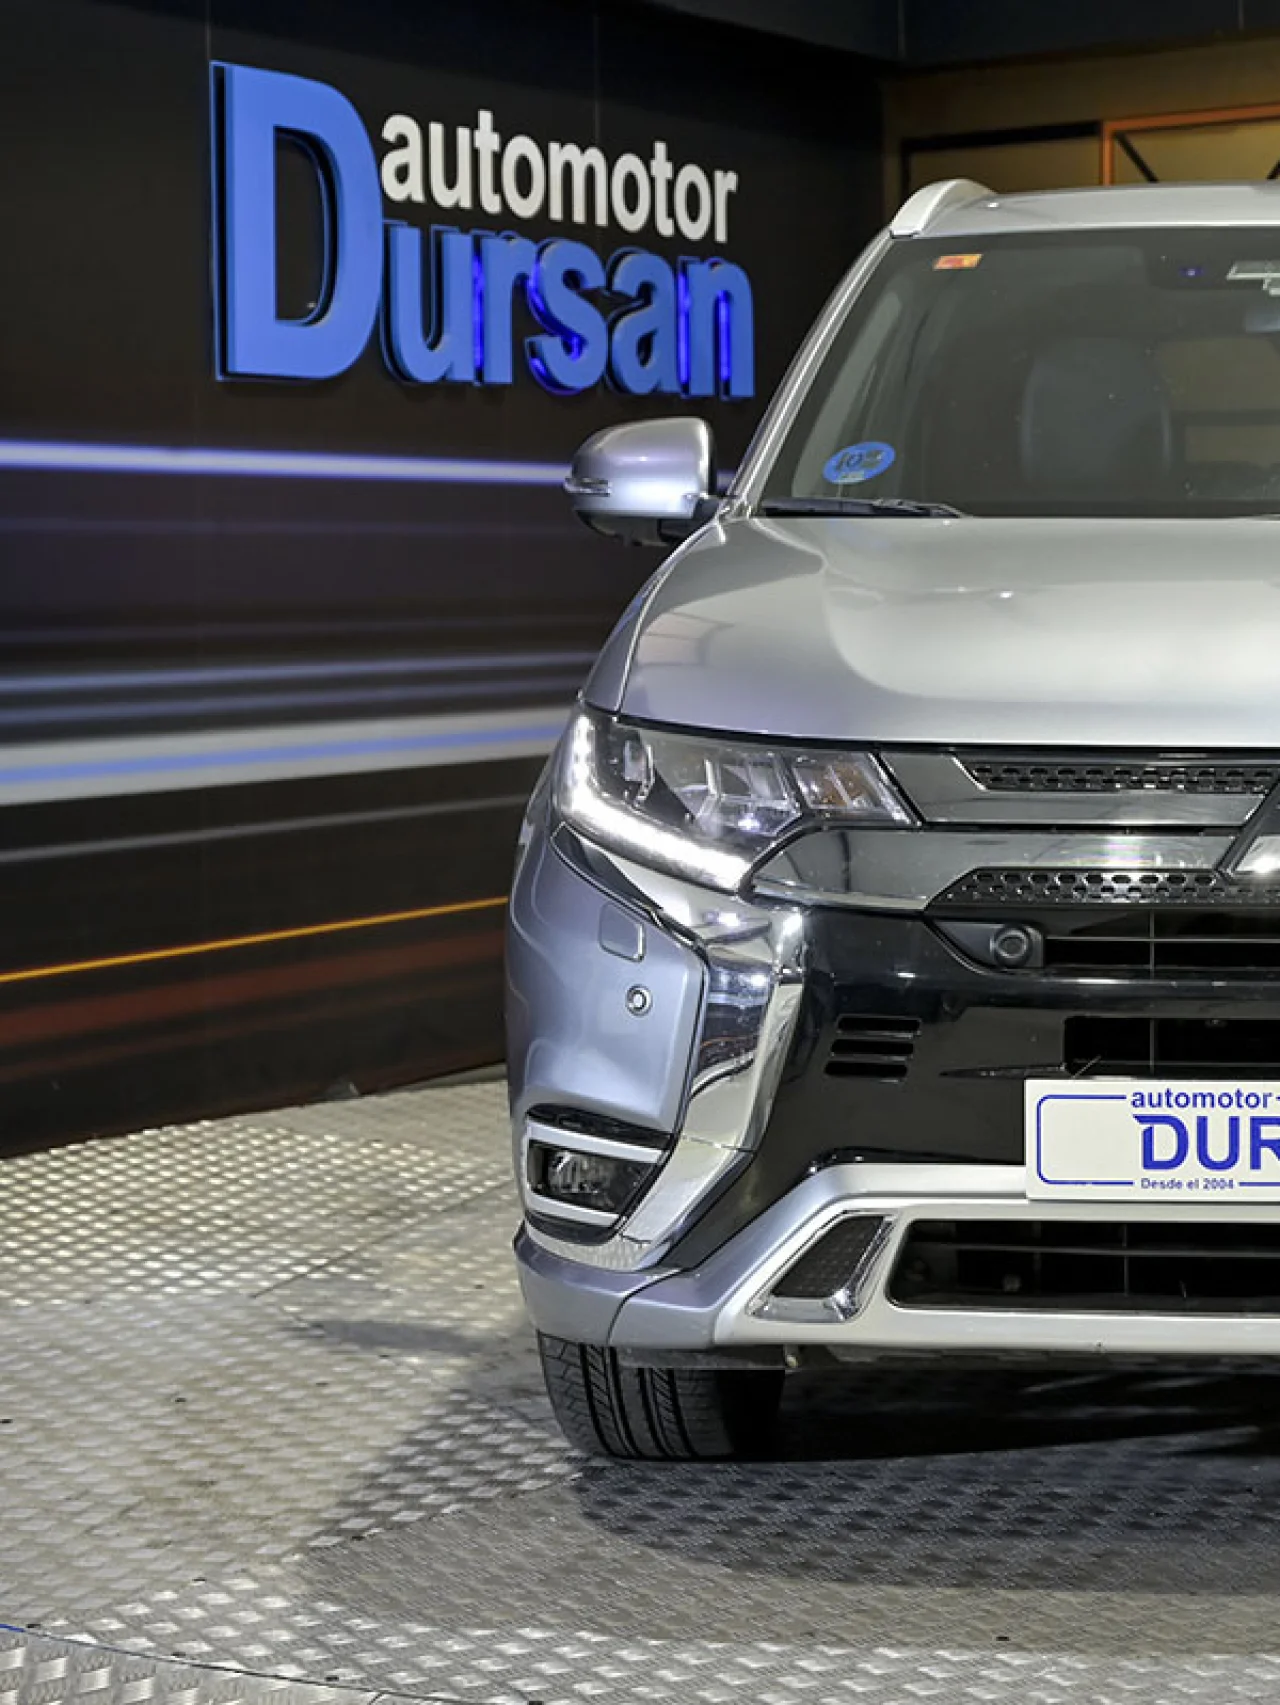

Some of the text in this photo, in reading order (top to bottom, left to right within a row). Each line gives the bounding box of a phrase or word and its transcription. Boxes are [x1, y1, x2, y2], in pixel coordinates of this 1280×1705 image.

[380, 109, 738, 243] automotor
[209, 60, 756, 399] Dursan
[1131, 1088, 1272, 1109] automotor
[1140, 1178, 1234, 1190] Desde el 2004
